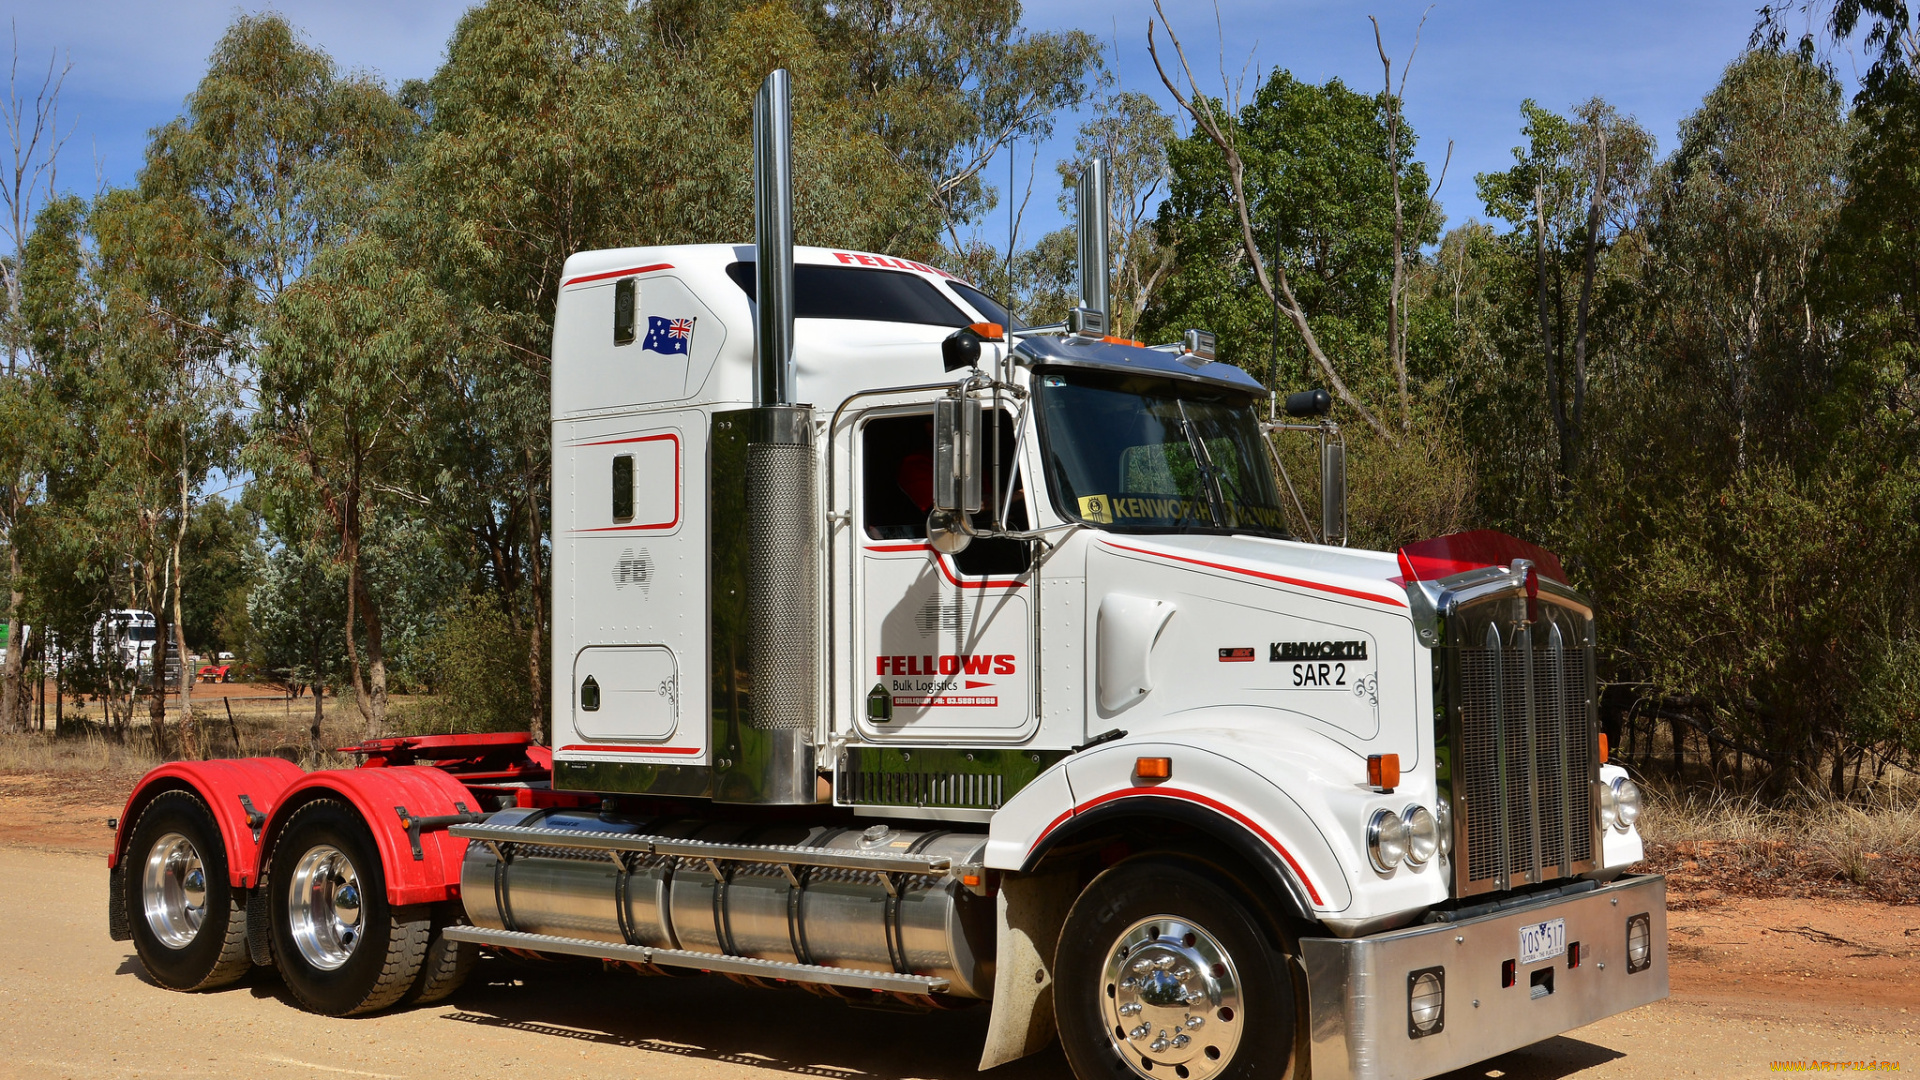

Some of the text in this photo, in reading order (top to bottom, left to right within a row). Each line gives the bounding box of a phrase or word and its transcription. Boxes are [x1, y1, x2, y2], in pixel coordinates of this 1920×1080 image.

[832, 252, 968, 286] FELLO
[1270, 641, 1367, 657] KENWORTH
[876, 654, 1016, 676] FELLOWS
[1293, 663, 1346, 686] SAR 2
[892, 679, 958, 694] Bulk Logistics
[1521, 924, 1563, 956] YOS 517
